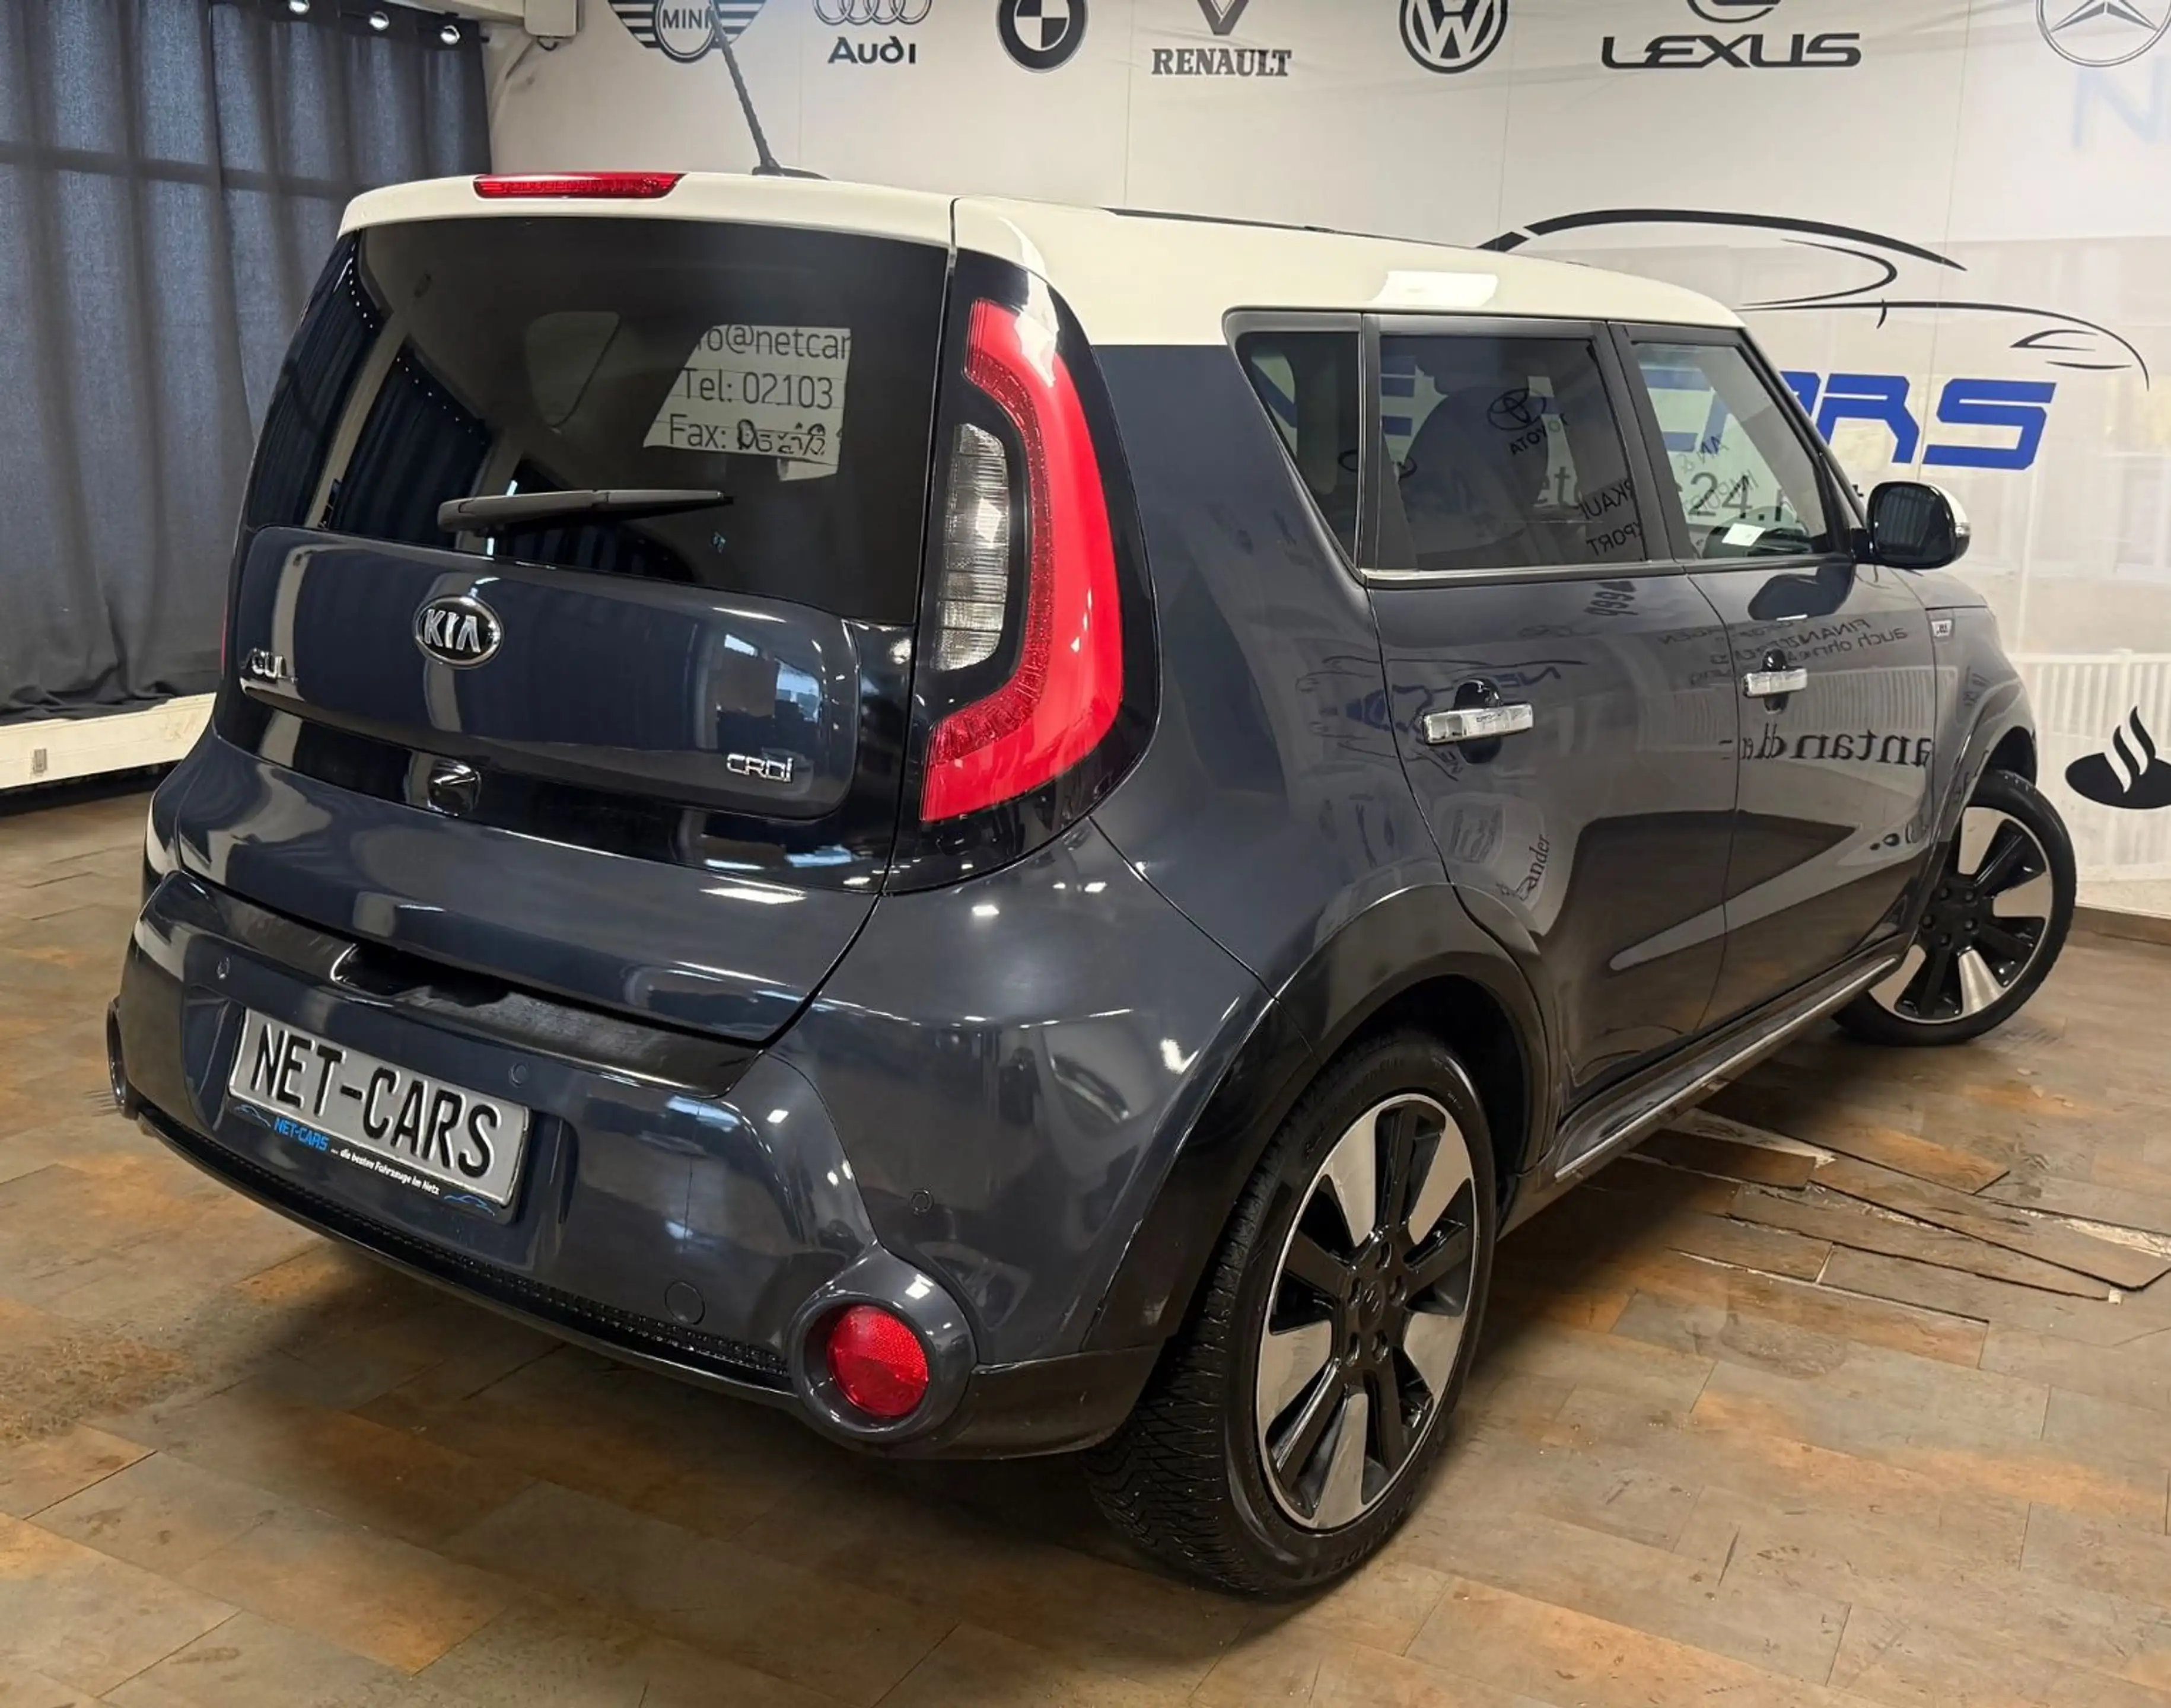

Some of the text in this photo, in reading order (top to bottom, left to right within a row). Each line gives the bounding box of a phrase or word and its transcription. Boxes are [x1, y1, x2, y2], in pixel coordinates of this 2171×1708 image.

[828, 36, 916, 64] Audi
[1152, 49, 1292, 77] RENAULT
[1602, 33, 1861, 68] LEXUS
[682, 368, 833, 409] Tel: 02103
[670, 414, 727, 449] Fax:
[424, 608, 481, 653] KIA
[250, 1022, 501, 1179] NET-CARS
[273, 1117, 330, 1152] NET-CARS
